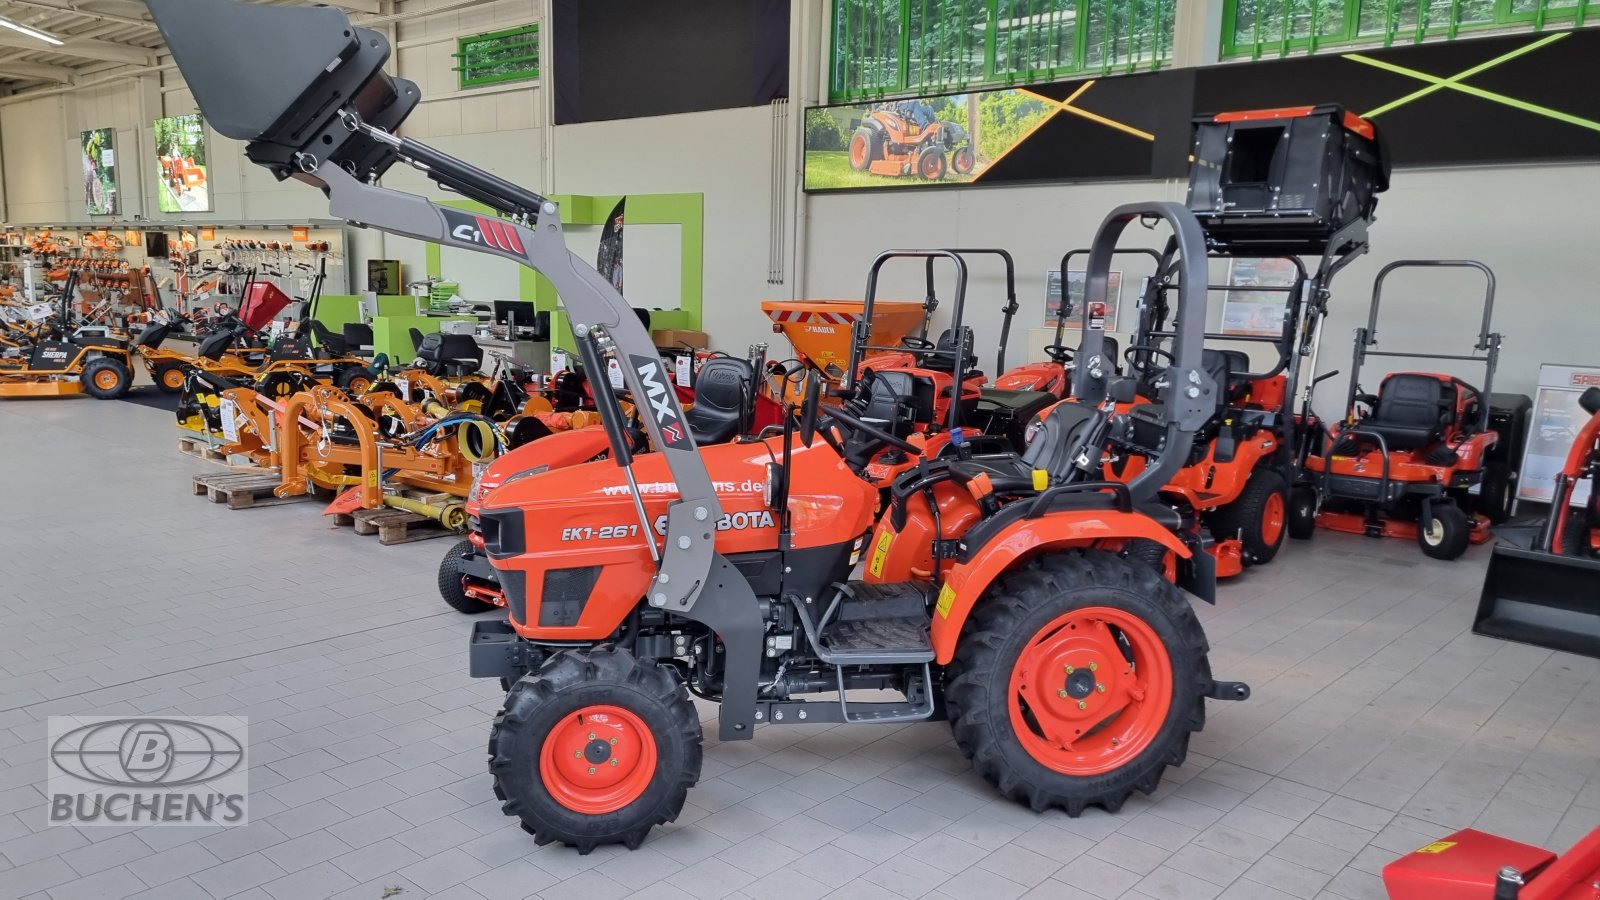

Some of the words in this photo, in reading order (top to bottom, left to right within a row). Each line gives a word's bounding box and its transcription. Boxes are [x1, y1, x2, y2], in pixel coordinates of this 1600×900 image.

[41, 351, 68, 359] SHERPA
[1572, 374, 1600, 386] SAB
[637, 362, 677, 424] MX
[714, 511, 776, 531] BOTA
[561, 524, 638, 541] EK1-261
